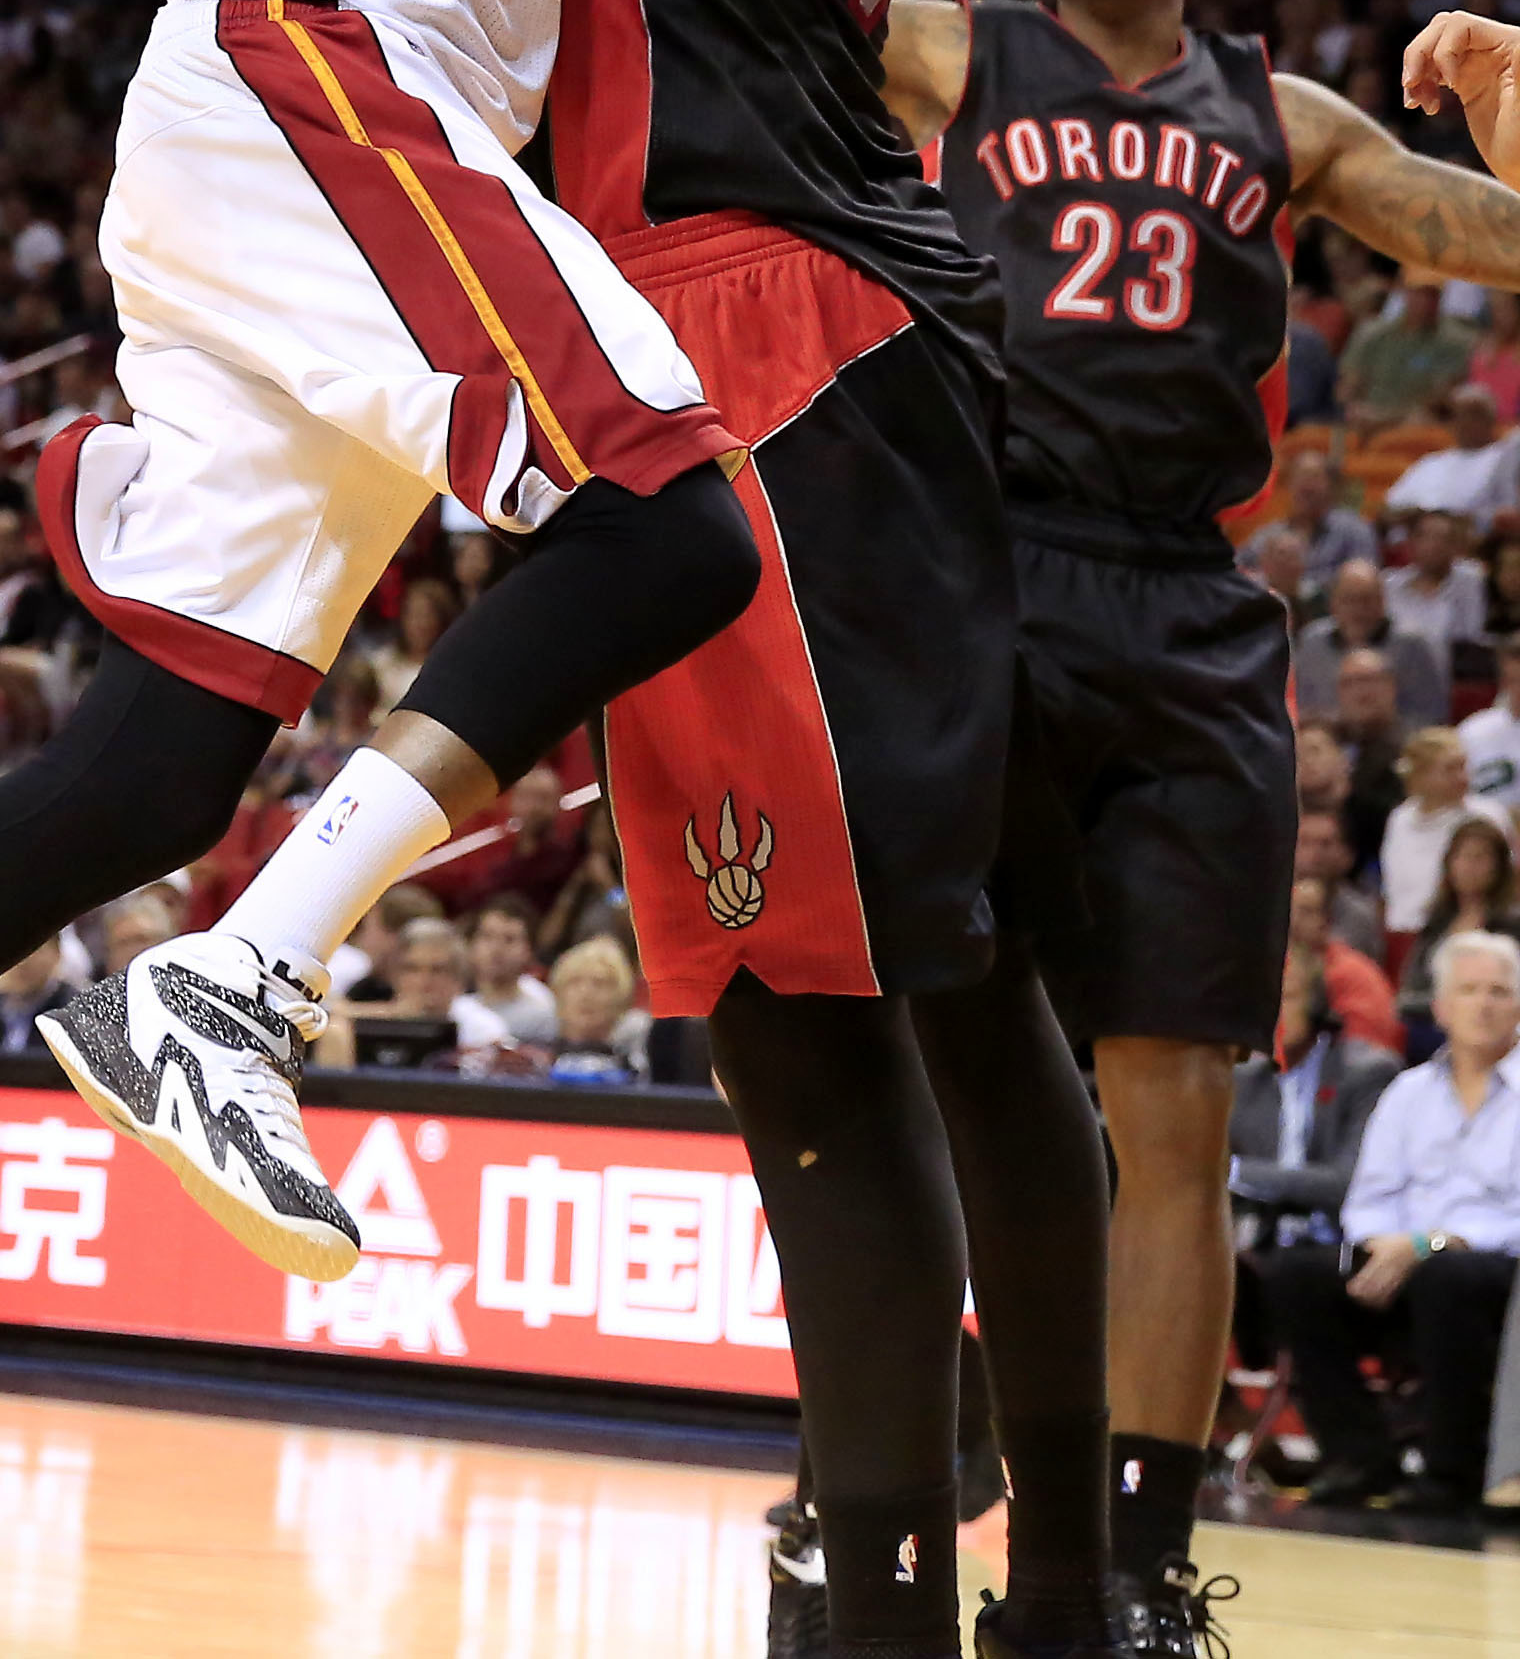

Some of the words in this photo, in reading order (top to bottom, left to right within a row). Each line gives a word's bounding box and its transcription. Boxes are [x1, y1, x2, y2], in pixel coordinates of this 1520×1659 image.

[977, 118, 1269, 237] TORONTO
[1042, 200, 1198, 333] 23
[284, 1256, 475, 1357] PEAK
